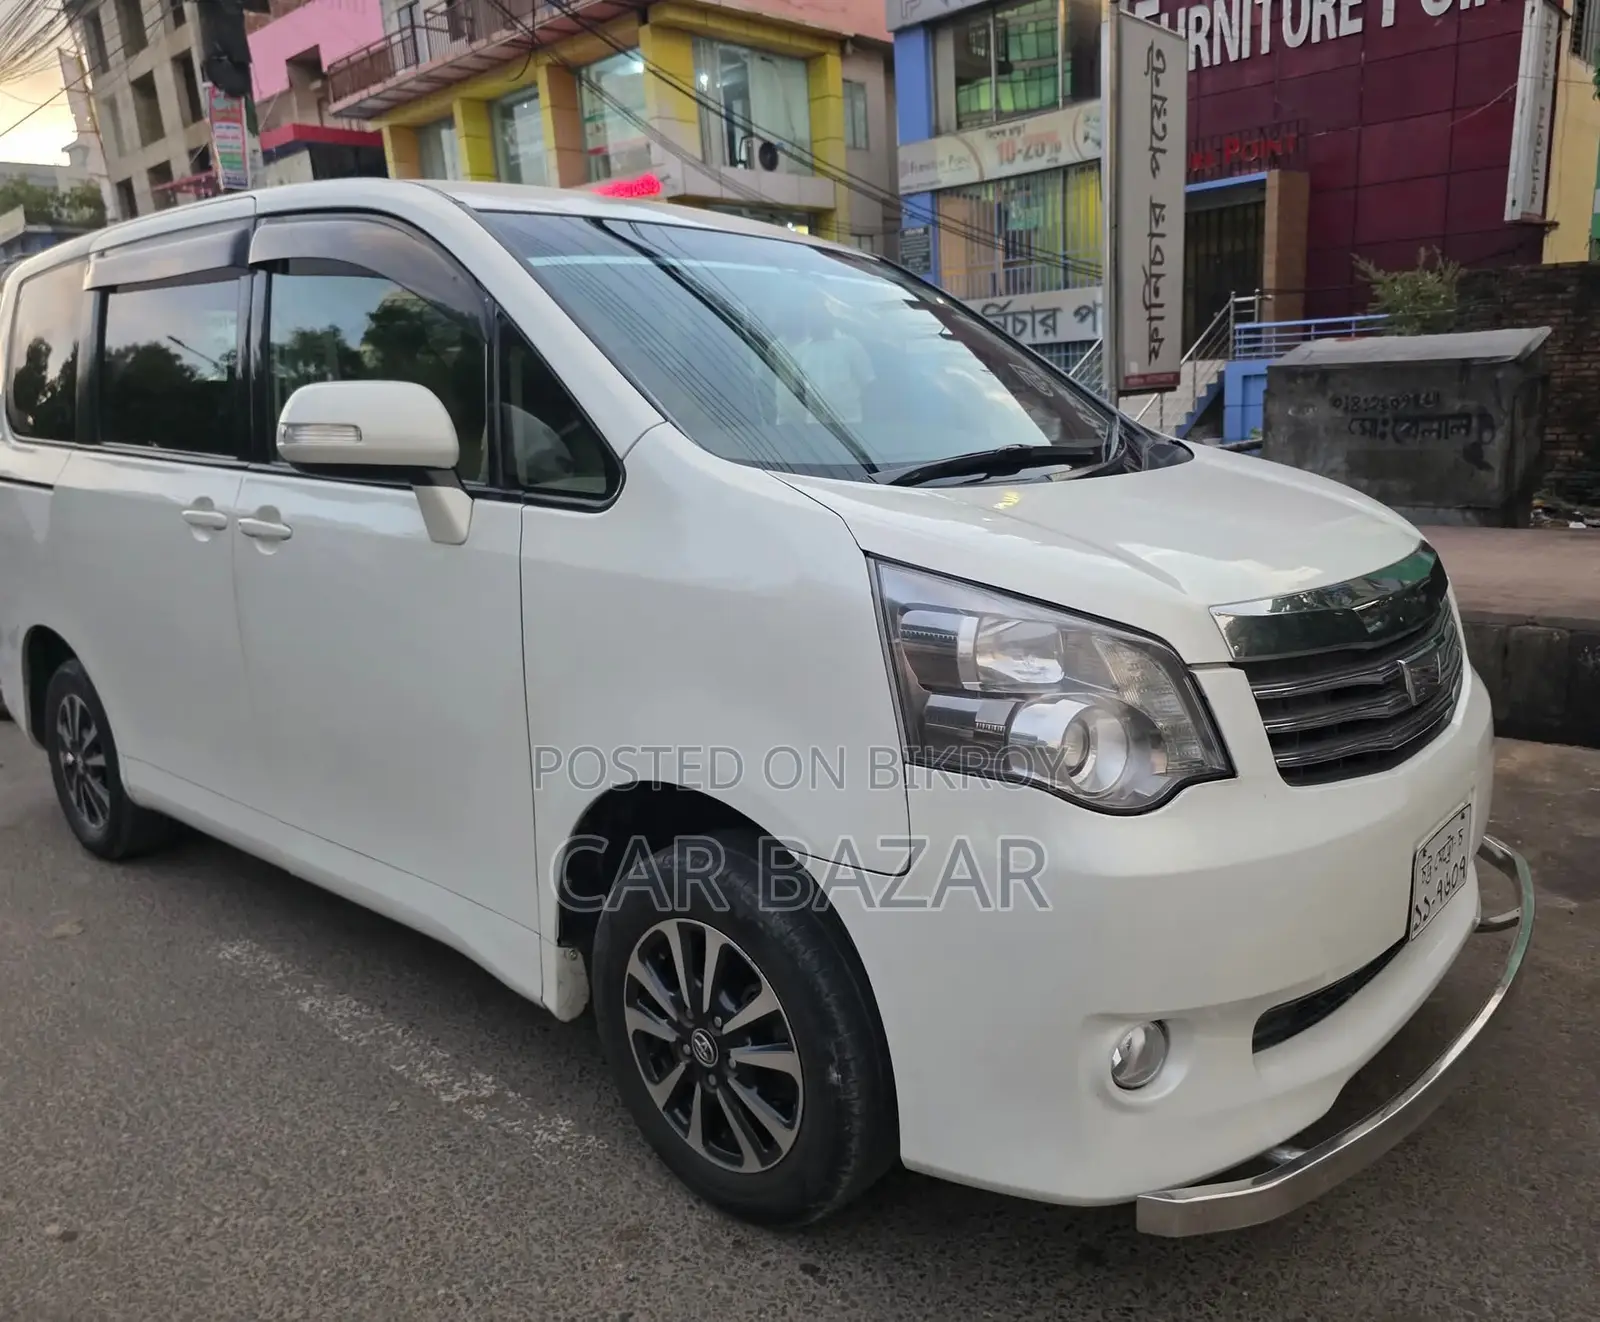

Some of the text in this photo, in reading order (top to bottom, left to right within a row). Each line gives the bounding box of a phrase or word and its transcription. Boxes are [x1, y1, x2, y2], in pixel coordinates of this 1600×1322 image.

[1135, 0, 1363, 72] RNITURE
[1143, 40, 1168, 180] পয়েন্ট
[980, 299, 1064, 339] র্নিচার
[1141, 196, 1167, 366] ফার্নিচার
